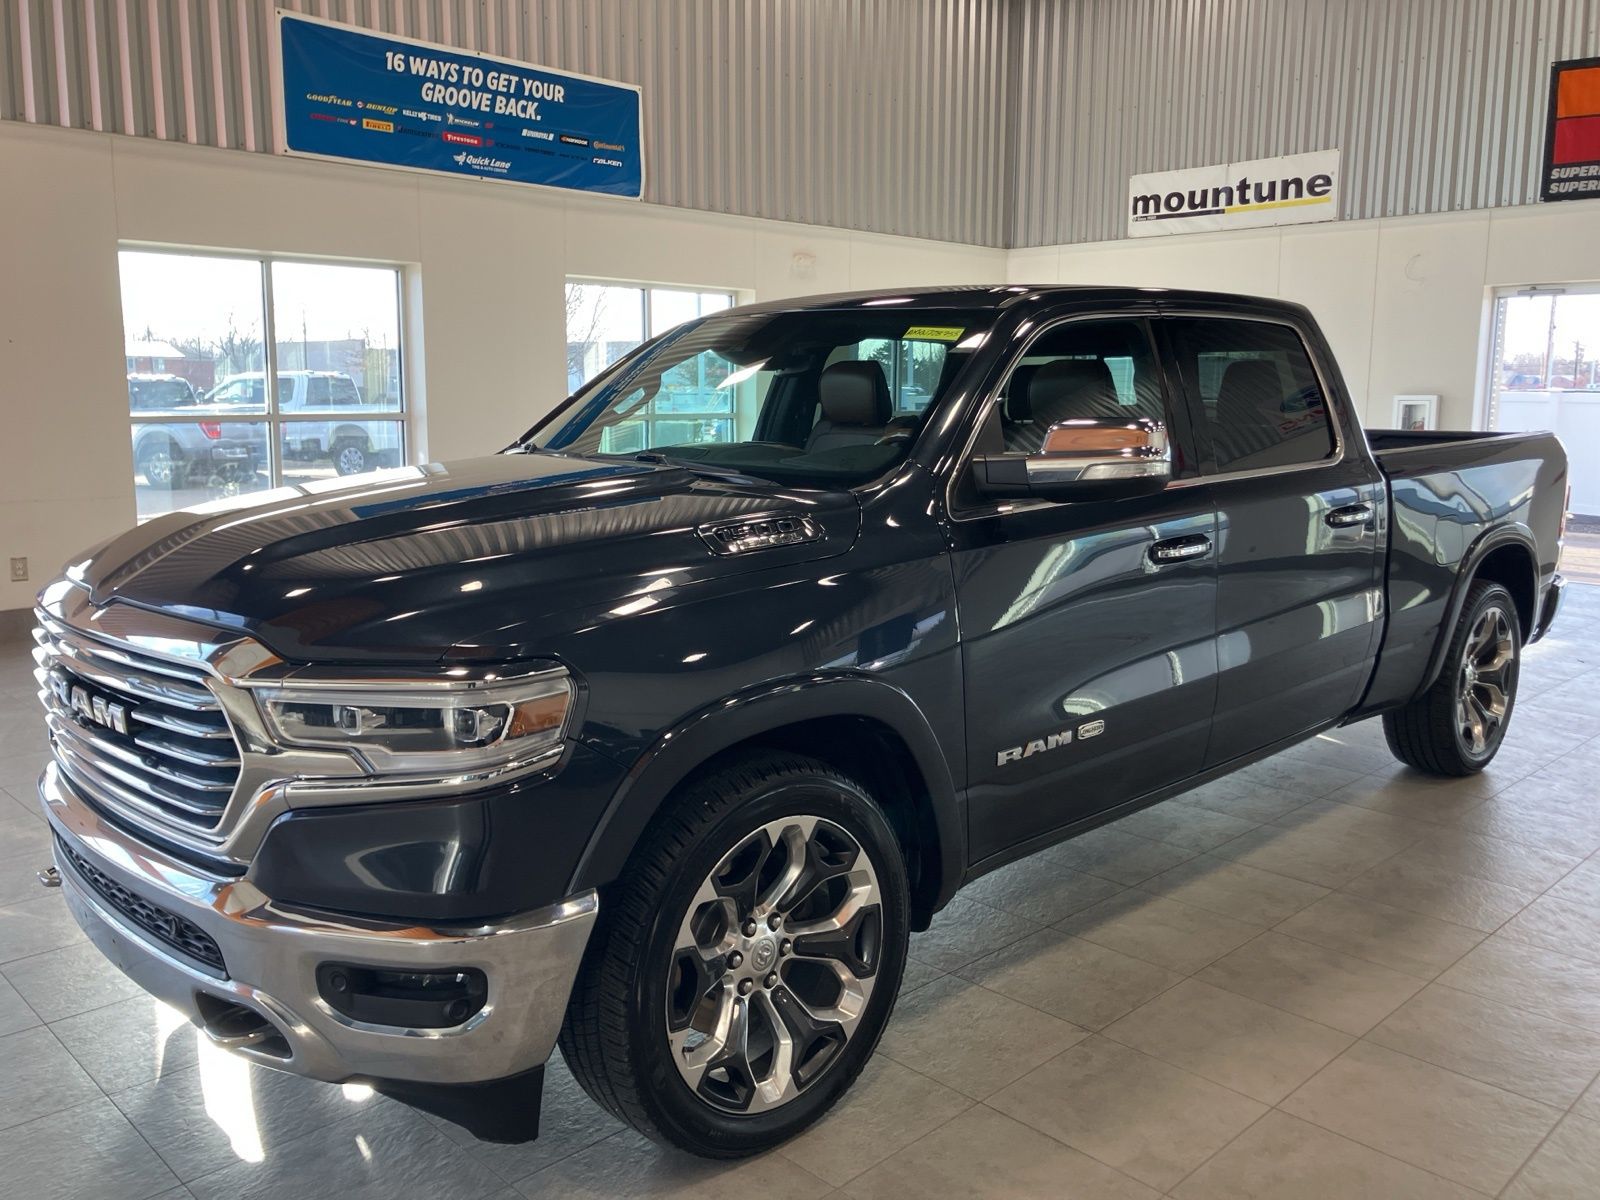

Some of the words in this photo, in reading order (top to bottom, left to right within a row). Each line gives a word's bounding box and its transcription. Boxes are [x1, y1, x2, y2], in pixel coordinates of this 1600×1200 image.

[386, 52, 405, 72] 16
[409, 56, 460, 83] WAYS
[462, 66, 484, 87] TO
[487, 71, 519, 93] GET
[523, 78, 565, 103] YOUR
[306, 93, 353, 107] GOODYEAR
[421, 82, 492, 112] GROOVE
[494, 95, 542, 121] BACK.
[366, 103, 398, 115] DUNLOP
[454, 118, 480, 127] MICHELIN
[446, 134, 478, 145] Firestone
[466, 155, 490, 166] Quick
[490, 158, 511, 169] Lane
[593, 157, 622, 167] FALKEN
[1550, 165, 1600, 179] SUPER
[1549, 180, 1600, 194] SUPER
[1132, 174, 1332, 216] mountune
[48, 669, 128, 736] RAM
[997, 730, 1072, 767] RAM
